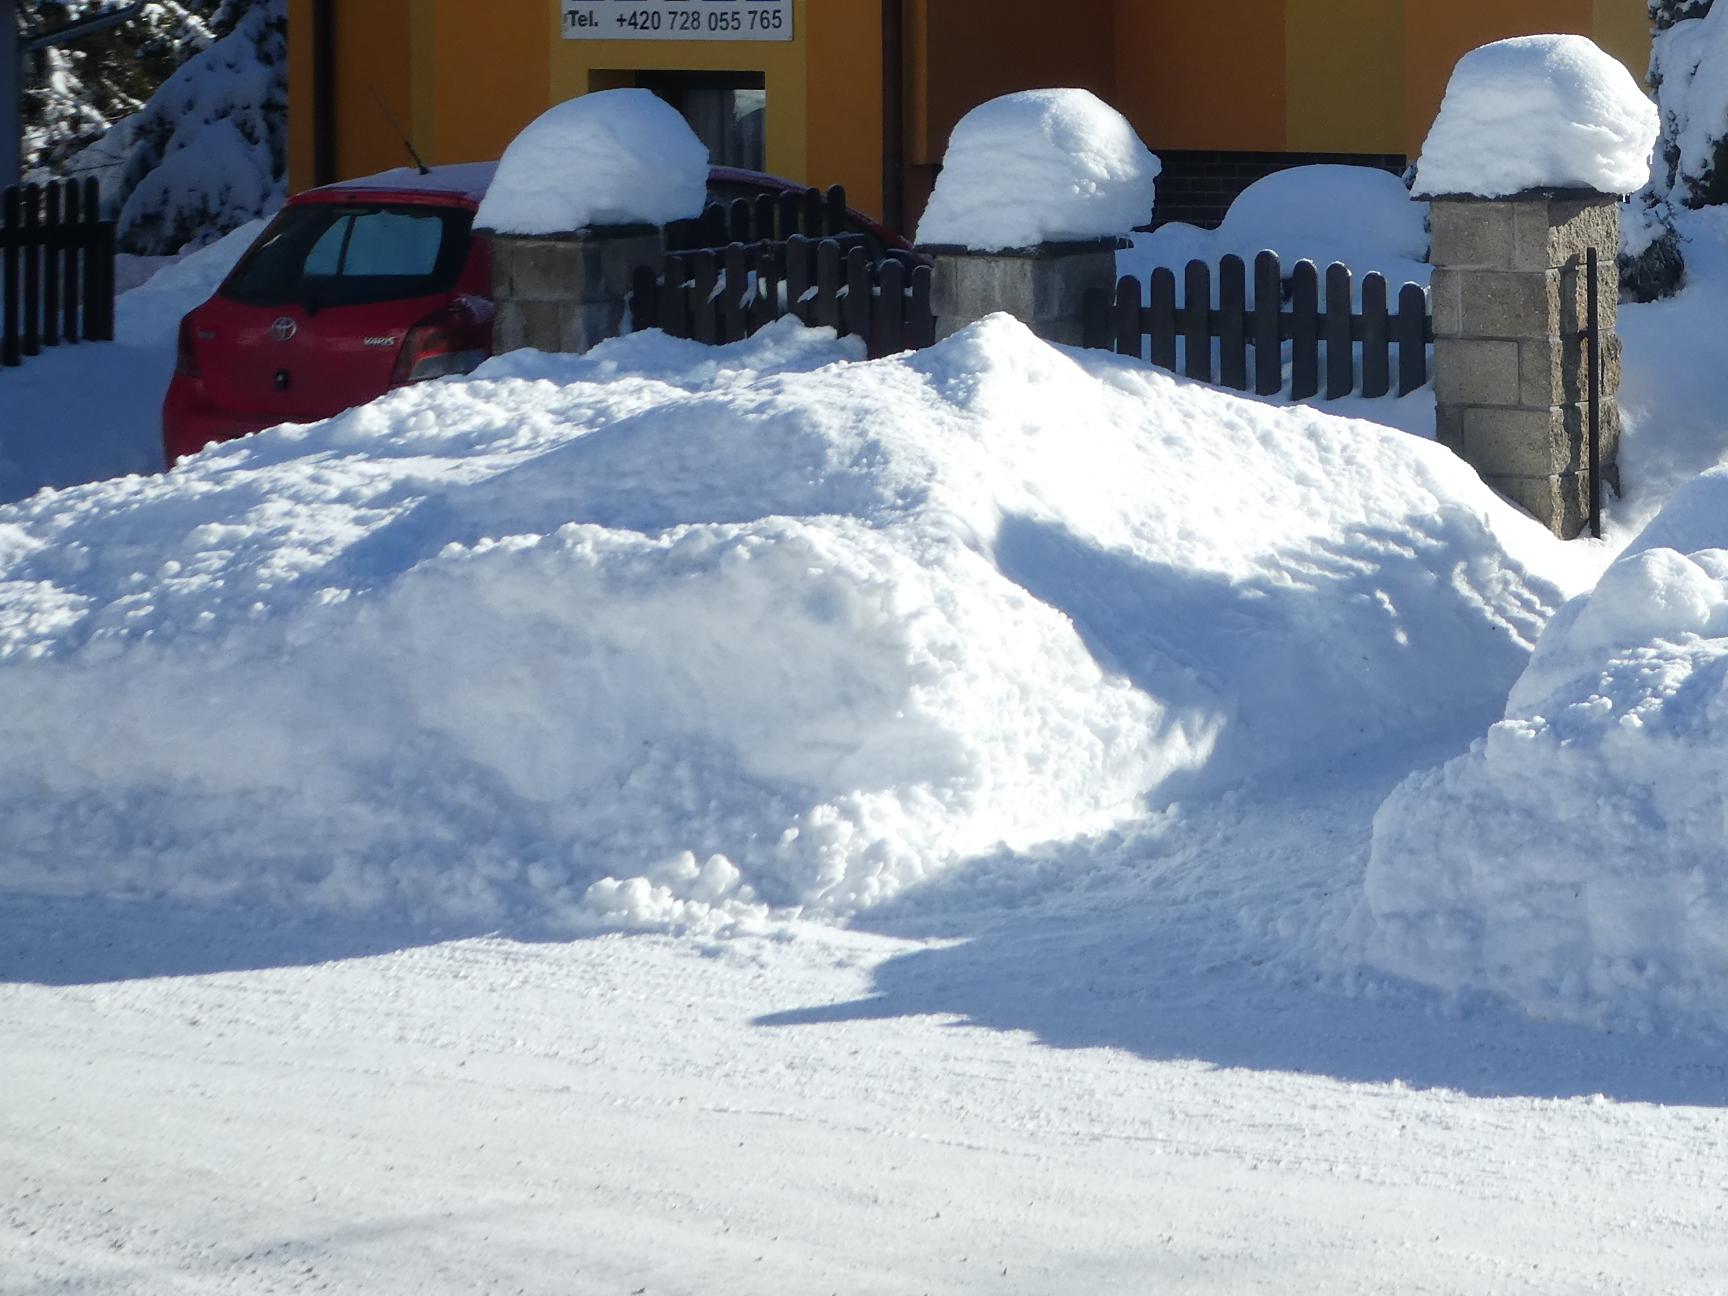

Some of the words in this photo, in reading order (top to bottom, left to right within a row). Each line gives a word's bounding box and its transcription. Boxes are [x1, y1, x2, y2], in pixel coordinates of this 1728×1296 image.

[567, 10, 599, 27] Tel.
[616, 10, 661, 30] +420
[668, 10, 701, 30] 728
[708, 11, 741, 31] 055
[747, 9, 782, 30] 765
